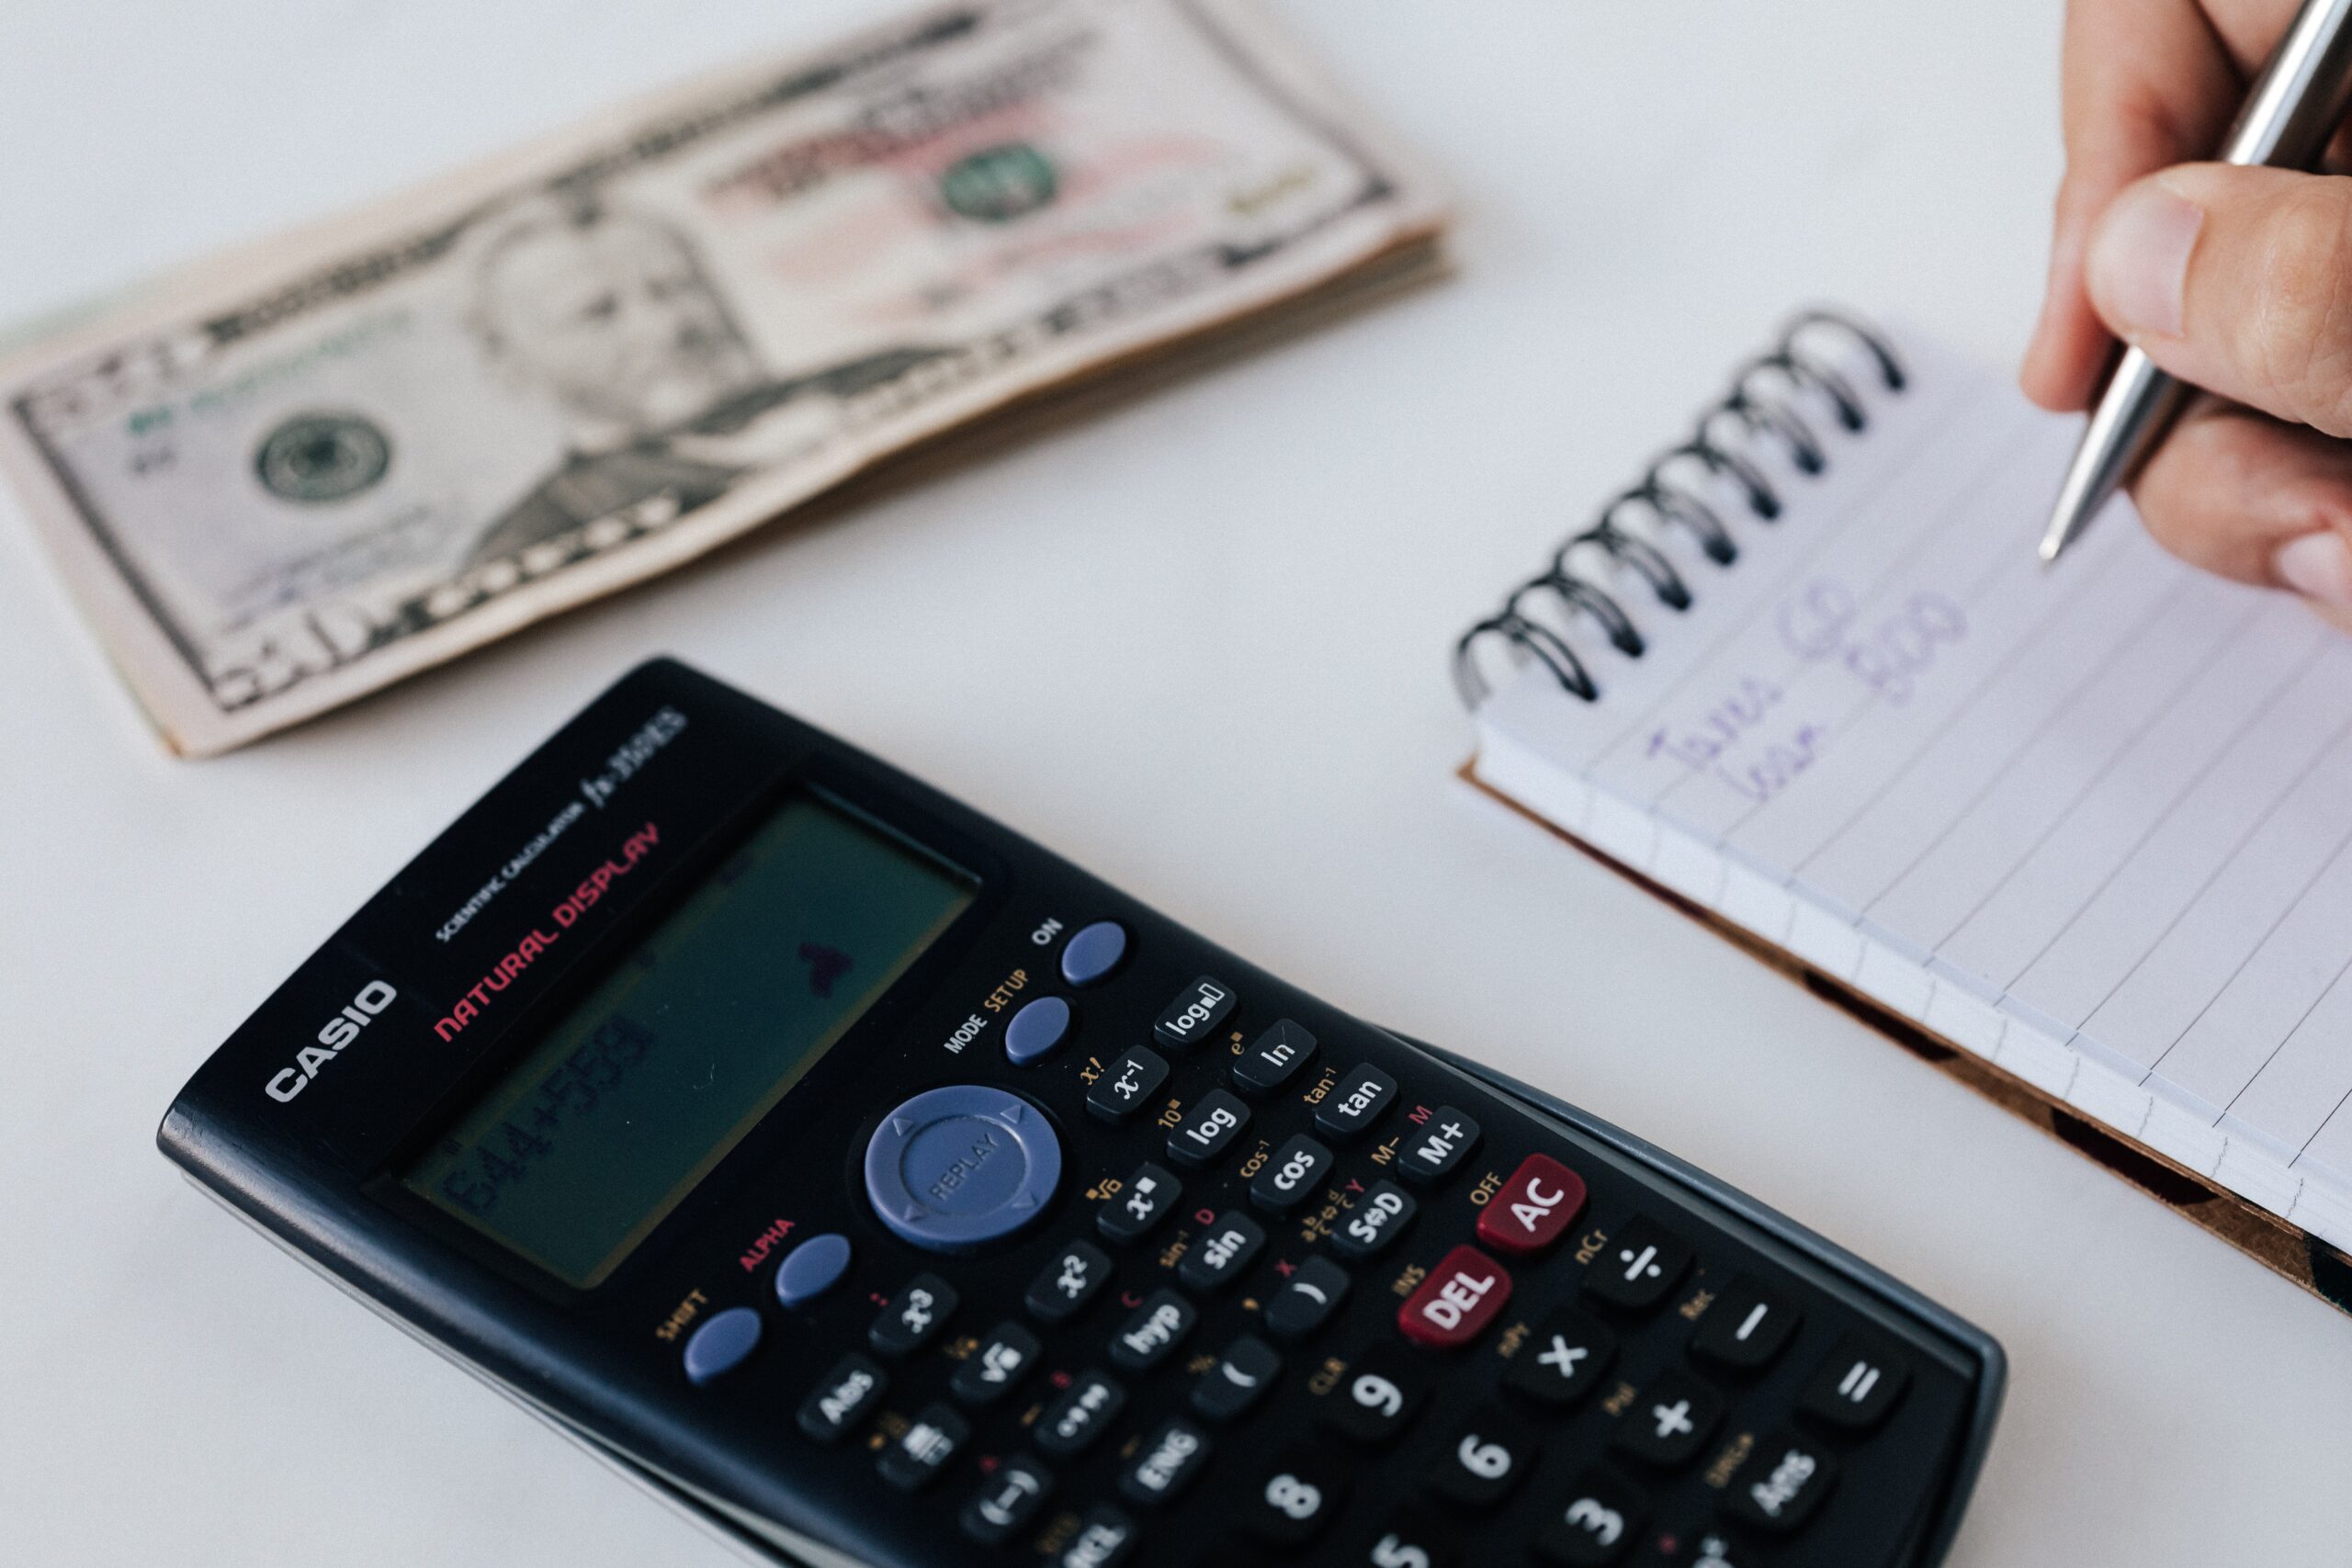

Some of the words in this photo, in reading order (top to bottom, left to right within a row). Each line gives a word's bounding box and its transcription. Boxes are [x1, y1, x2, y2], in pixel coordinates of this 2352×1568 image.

[433, 928, 560, 1043] NATURAL
[552, 821, 660, 929] DISPLAY
[435, 875, 506, 942] SCIENTIFIC
[1031, 917, 1064, 946] ON
[944, 1014, 988, 1055] MODE
[984, 968, 1029, 1013] SETUP
[265, 979, 398, 1103] CASIO
[1260, 1043, 1296, 1067] ln
[1337, 1080, 1384, 1118] tan
[1407, 1104, 1433, 1126] M
[1186, 1107, 1238, 1145] log
[1416, 1122, 1464, 1166] M+
[929, 1131, 999, 1201] REPLAY
[1273, 1149, 1316, 1190] cos
[1469, 1171, 1503, 1206] OFF
[1194, 1208, 1216, 1225] D
[1510, 1177, 1565, 1233] AC
[739, 1219, 796, 1273] ALPHA
[1203, 1229, 1247, 1269] sin
[1390, 1262, 1427, 1296] INS
[1421, 1271, 1497, 1331] DEL
[654, 1287, 709, 1343] SHIFT
[818, 1370, 874, 1426] Abs
[1351, 1373, 1404, 1418] 9
[1457, 1433, 1512, 1480] 6
[1263, 1472, 1323, 1520] 8
[1564, 1496, 1625, 1548] 3
